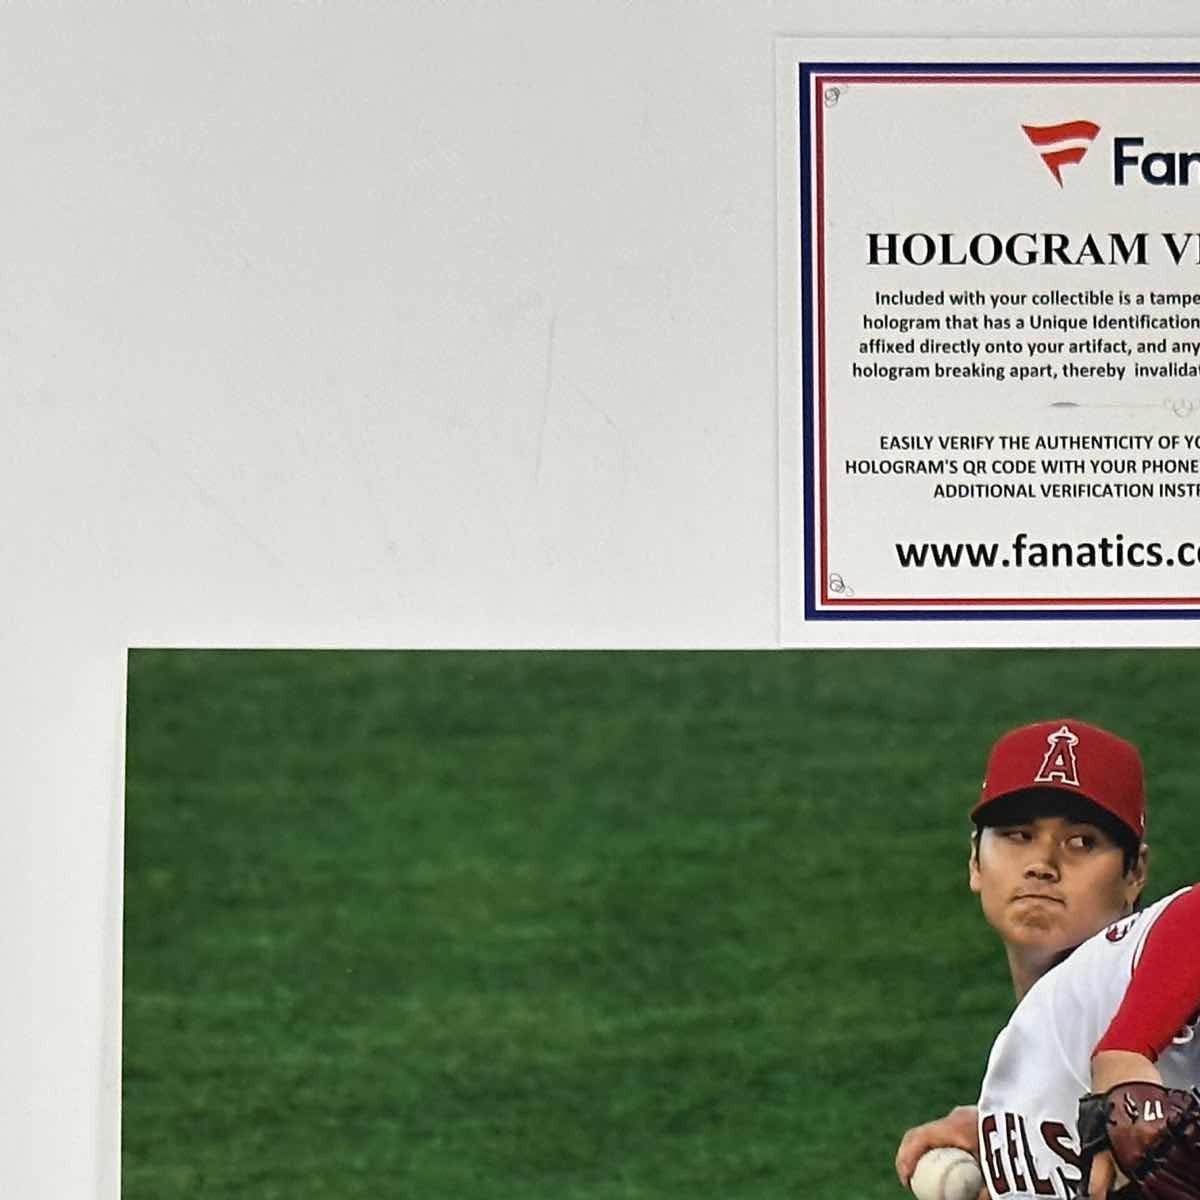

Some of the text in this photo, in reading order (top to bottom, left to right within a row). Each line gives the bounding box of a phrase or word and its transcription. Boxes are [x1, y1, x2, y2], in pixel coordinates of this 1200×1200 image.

[868, 232, 1149, 266] HOLOGRAM
[875, 290, 945, 306] Included
[949, 290, 986, 306] with
[990, 294, 1027, 309] your
[1031, 289, 1114, 306] collectible
[1118, 290, 1131, 305] is
[1135, 294, 1145, 305] a
[863, 314, 941, 333] hologram
[945, 314, 979, 330] that
[983, 314, 1011, 330] has
[1015, 318, 1025, 330] a
[1029, 314, 1088, 333] Unique
[1092, 314, 1200, 330] Identification
[859, 338, 915, 354] affixed
[919, 338, 981, 357] directly
[984, 340, 1023, 354] onto
[1027, 342, 1065, 357] your
[1068, 338, 1132, 356] artifact,
[1136, 338, 1167, 354] and
[1171, 342, 1200, 357] any
[852, 362, 930, 381] hologram
[935, 362, 1006, 381] breaking
[1009, 364, 1058, 381] apart,
[1062, 362, 1126, 381] thereby
[880, 435, 934, 450] EASILY
[938, 435, 995, 450] VERIFY
[998, 435, 1030, 450] THE
[1035, 435, 1154, 450] AUTHENTICITY
[1158, 435, 1180, 450] OF
[845, 459, 959, 475] HOLOGRAM'S
[962, 459, 987, 477] QR
[991, 460, 1037, 474] CODE
[1041, 459, 1085, 474] WITH
[1089, 459, 1137, 474] YOUR
[1142, 459, 1199, 474] PHONE
[933, 483, 1036, 499] ADDITIONAL
[1040, 483, 1154, 498] VERIFICATION
[1034, 726, 1080, 786] A
